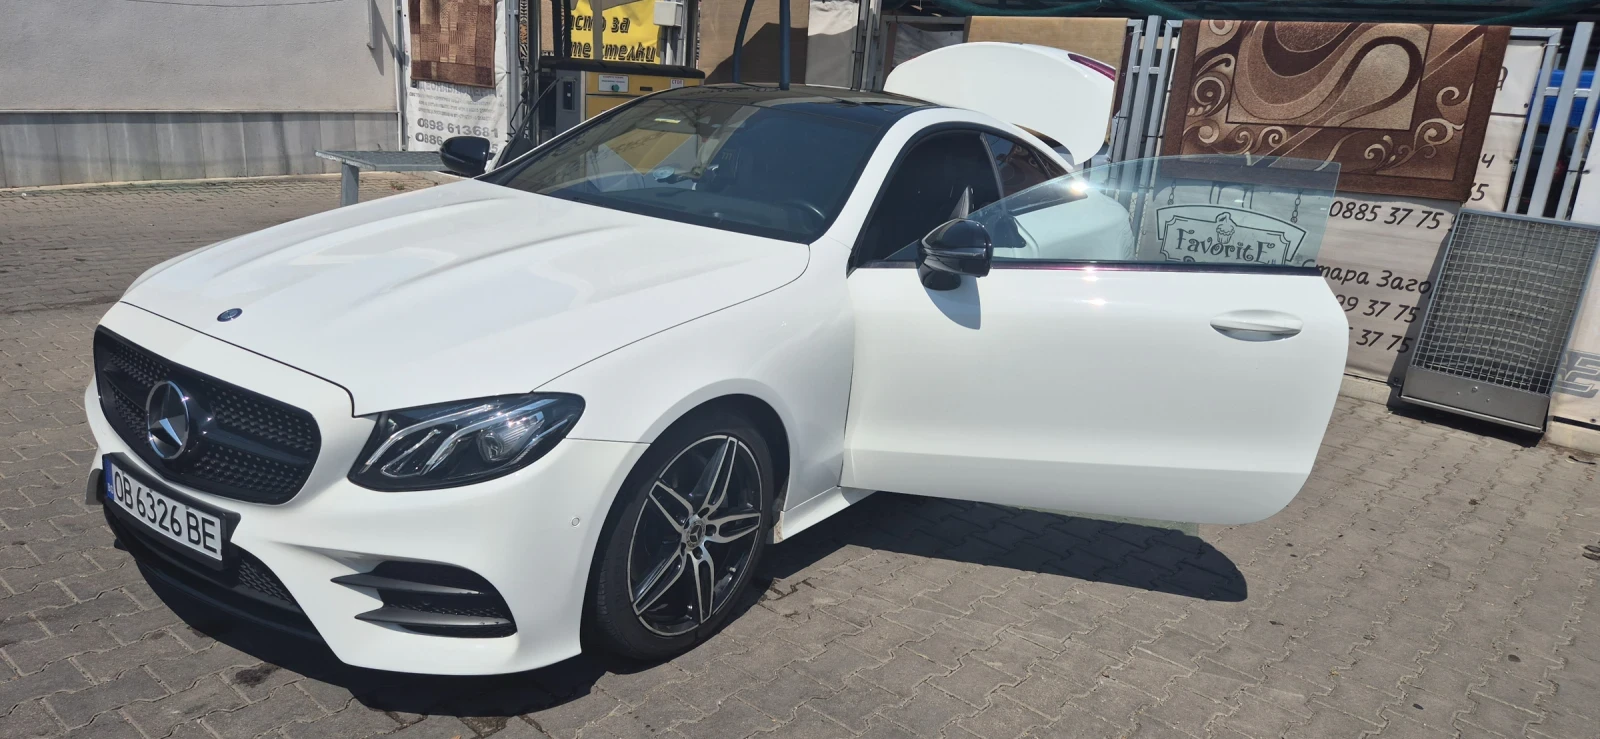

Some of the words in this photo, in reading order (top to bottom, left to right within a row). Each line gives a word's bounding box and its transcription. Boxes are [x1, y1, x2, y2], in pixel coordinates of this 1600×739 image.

[611, 17, 631, 34] за
[602, 42, 656, 62] телки
[447, 122, 499, 138] 613681
[1329, 200, 1382, 222] 0885
[1384, 206, 1413, 225] 37
[1416, 210, 1444, 230] 75
[1376, 269, 1433, 298] Заго
[1363, 299, 1391, 317] 37
[1394, 304, 1420, 323] 75
[1356, 329, 1384, 347] 37
[1387, 335, 1414, 353] 75
[114, 471, 134, 510] OB
[136, 486, 182, 537] 6326
[186, 510, 217, 554] BE
